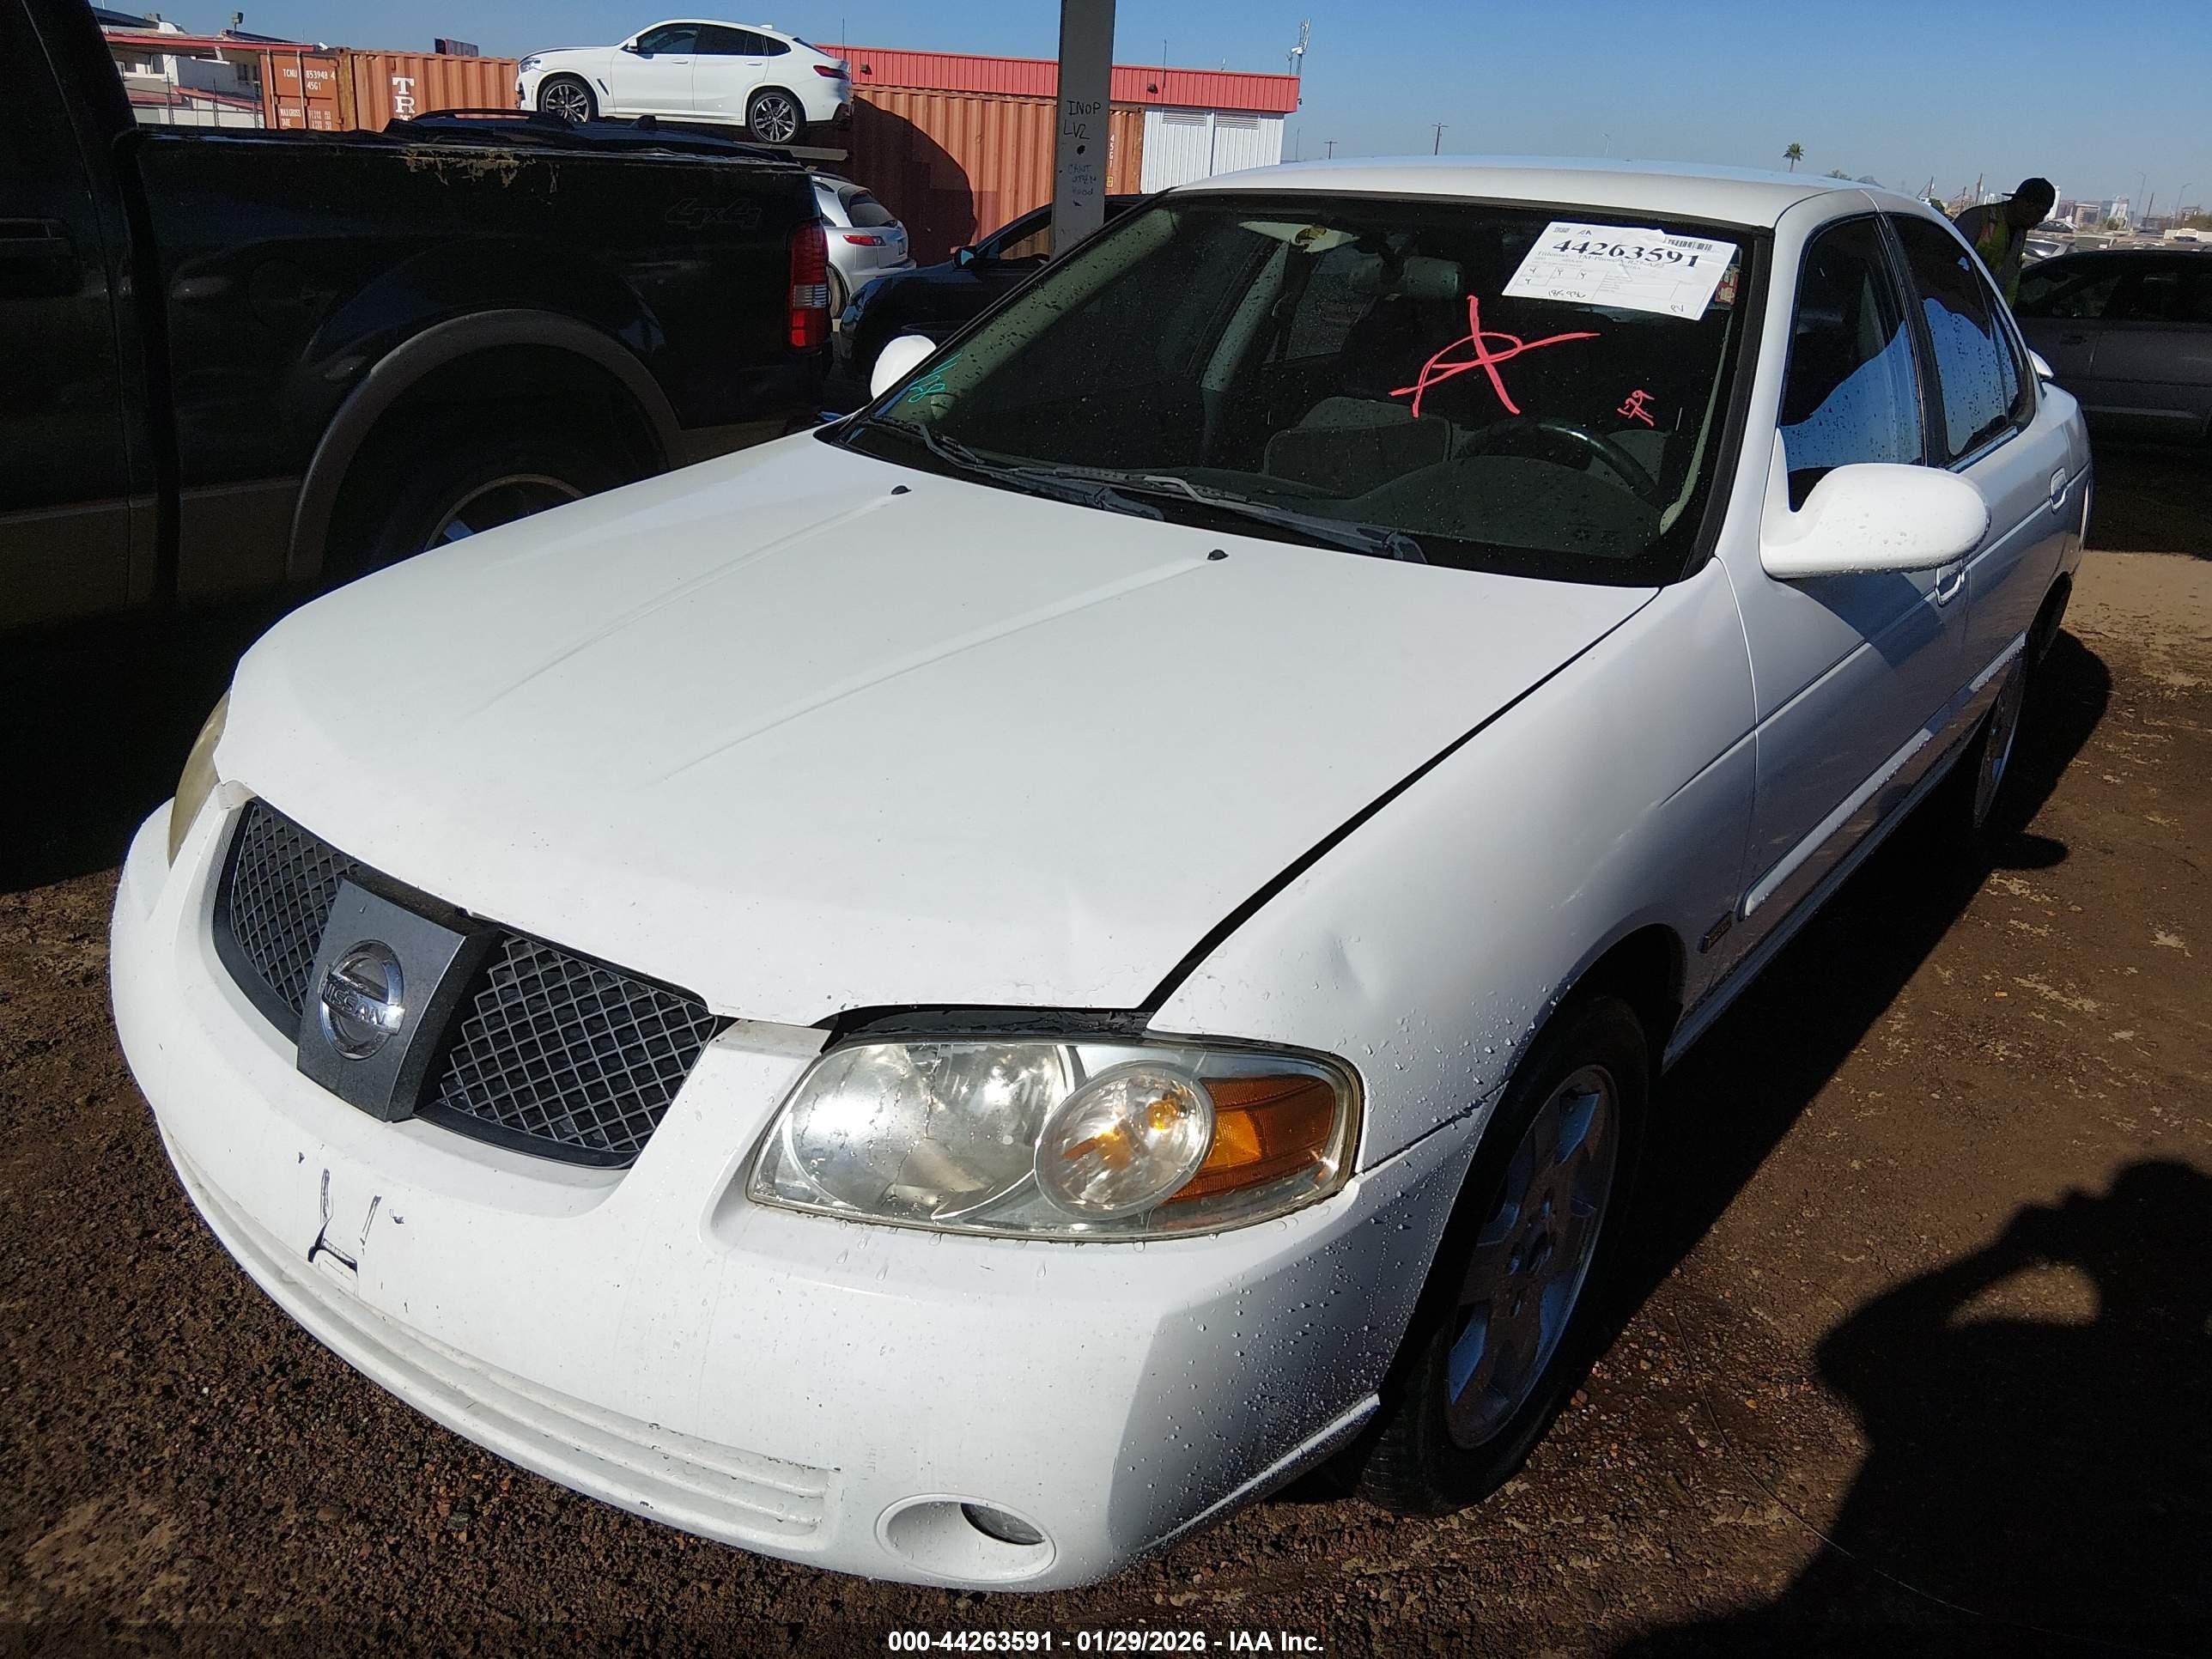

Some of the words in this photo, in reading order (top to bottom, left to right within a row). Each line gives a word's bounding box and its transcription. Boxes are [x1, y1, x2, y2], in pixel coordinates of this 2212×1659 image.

[331, 71, 336, 81] 4
[307, 82, 321, 90] 45G1
[1066, 100, 1101, 116] INOP
[1553, 240, 1699, 268] 44263591
